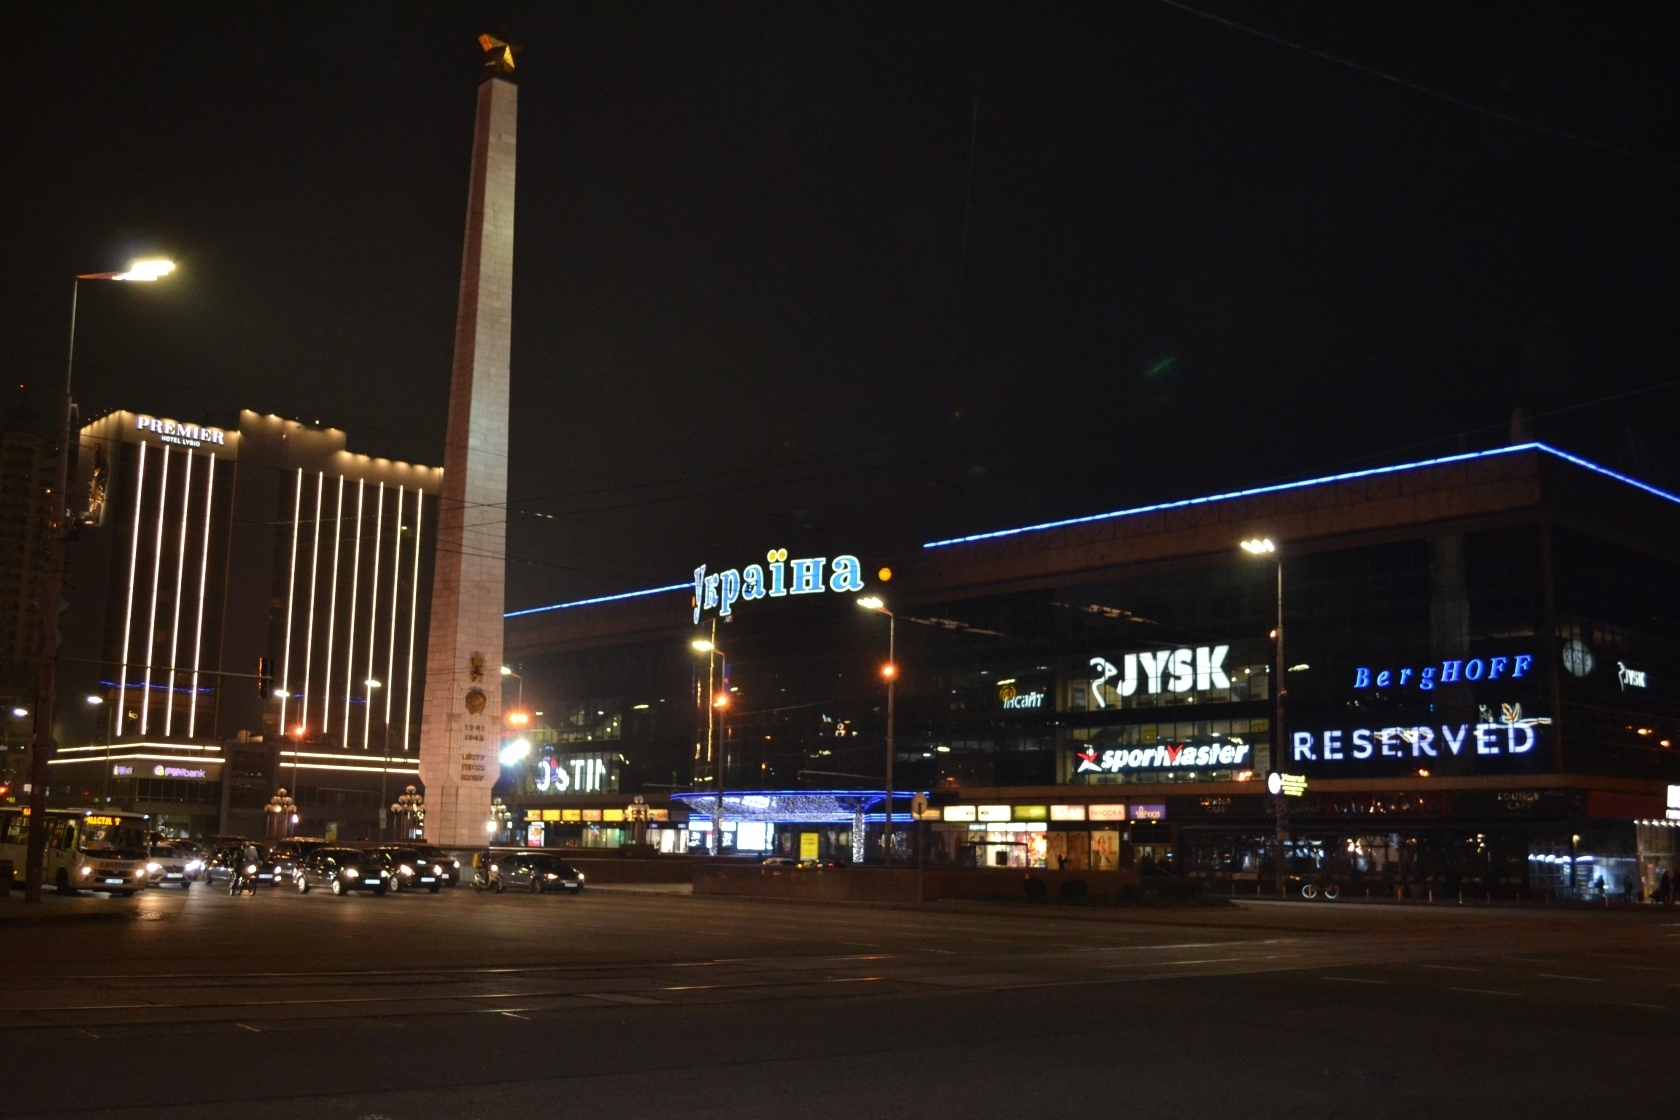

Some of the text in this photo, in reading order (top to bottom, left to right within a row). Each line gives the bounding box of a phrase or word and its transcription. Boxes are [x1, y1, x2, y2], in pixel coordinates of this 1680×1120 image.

[137, 415, 225, 445] PREMIER
[161, 435, 181, 444] HOTEL
[693, 548, 865, 625] Україна
[1117, 645, 1231, 697] JYSK
[1353, 654, 1532, 690] BergHOFF
[1623, 668, 1647, 688] JYSK
[1292, 721, 1535, 761] RESERVED
[1497, 792, 1540, 802] LOUNGE
[1090, 809, 1123, 818] PANDORA
